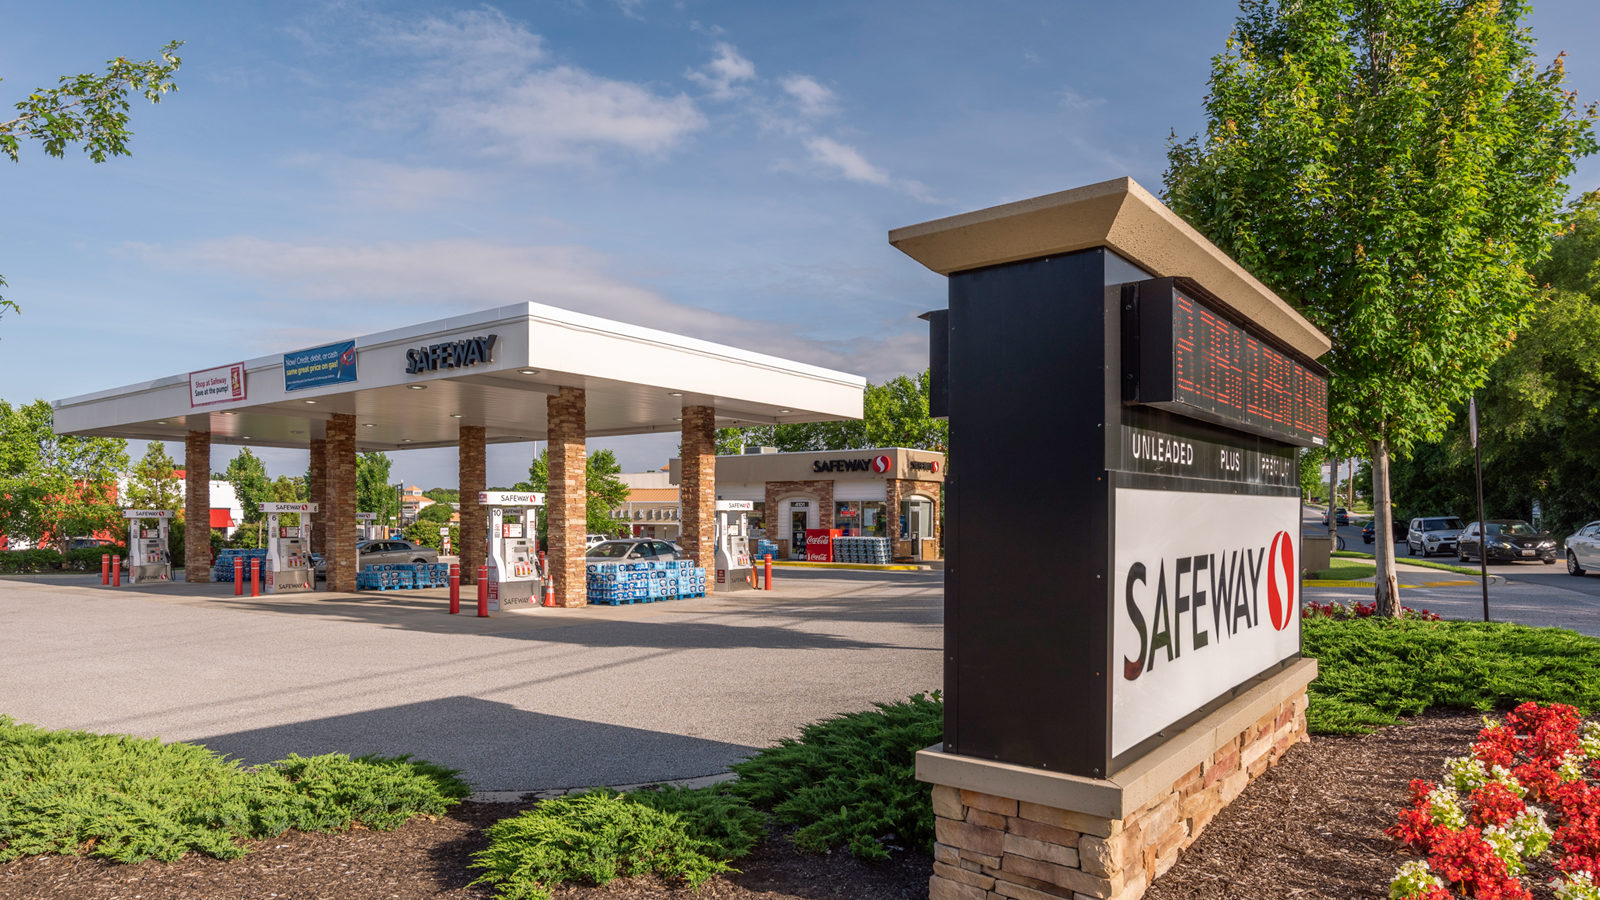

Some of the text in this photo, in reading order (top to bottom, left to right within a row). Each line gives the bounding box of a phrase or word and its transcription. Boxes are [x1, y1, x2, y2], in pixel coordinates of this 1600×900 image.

[405, 334, 498, 374] SAFEWAY
[298, 366, 309, 376] great
[310, 364, 321, 373] price
[329, 360, 338, 370] gas!
[216, 384, 228, 394] pump!
[1132, 433, 1194, 466] UNLEADED
[813, 458, 872, 473] SAFEWAY
[1220, 450, 1240, 472] PLUS
[501, 494, 530, 502] SAFEWAY
[504, 596, 530, 606] SAFEWAY
[1124, 546, 1266, 681] SAFEWAY
